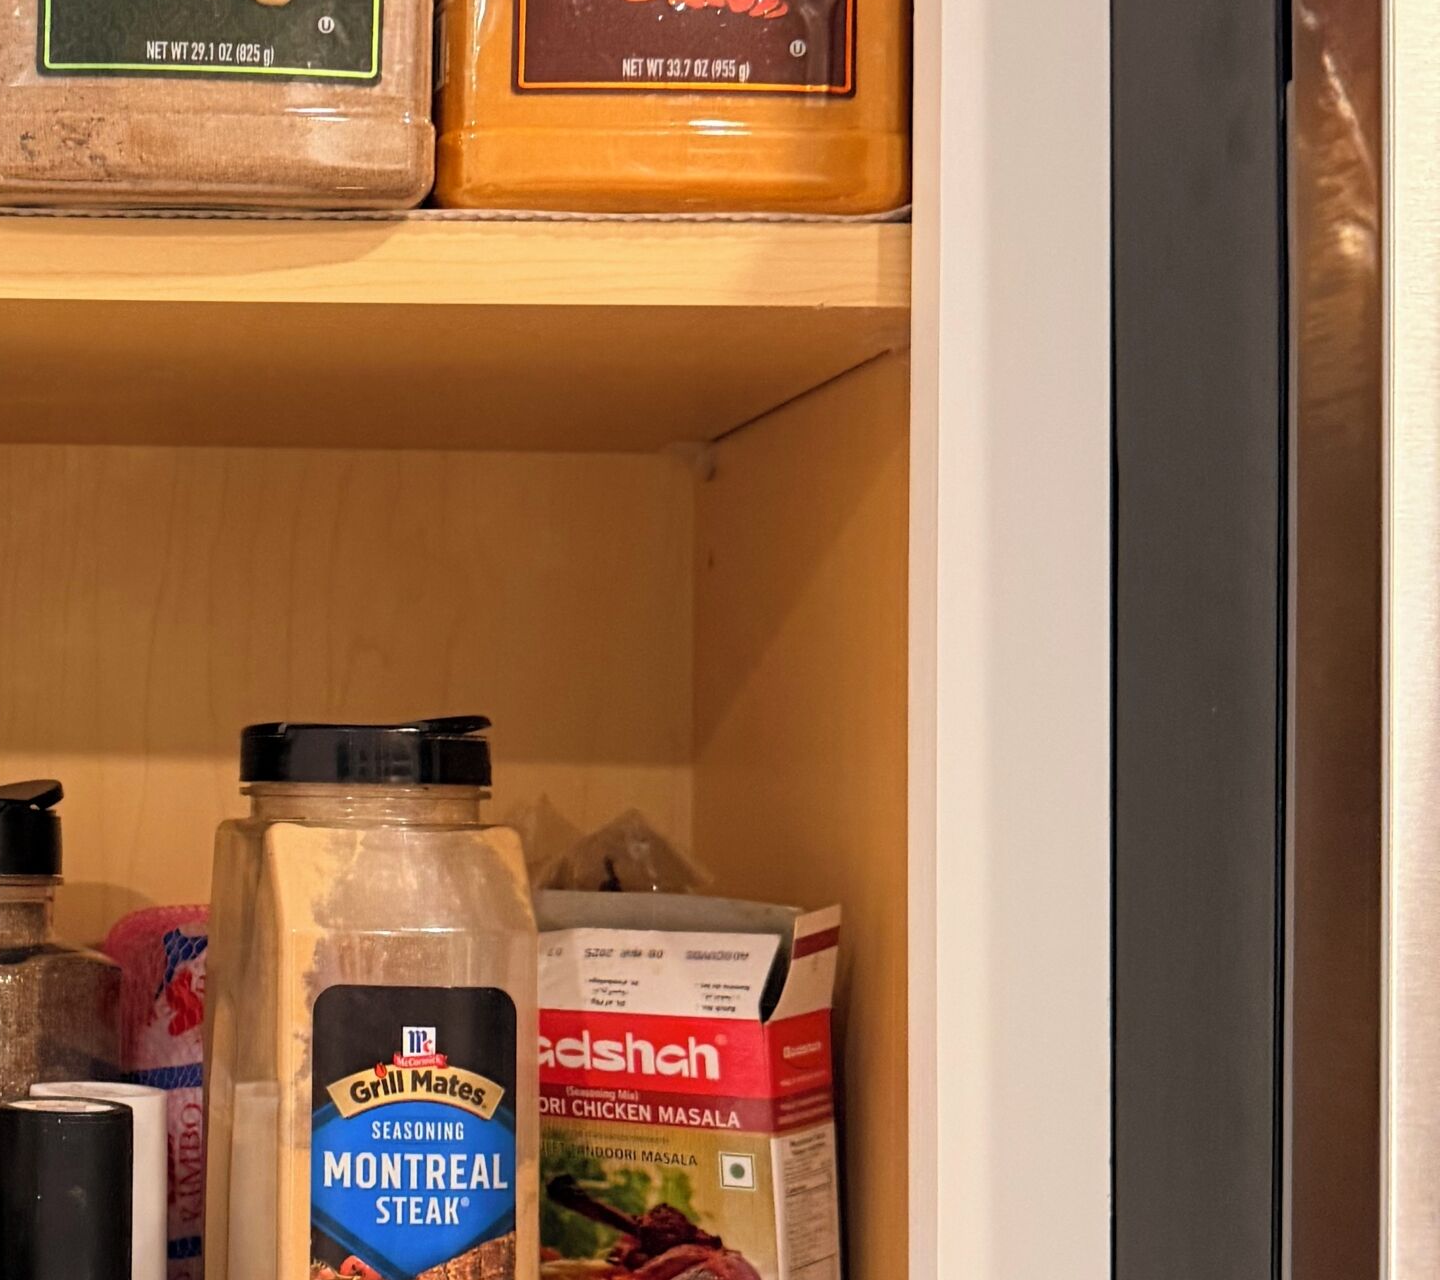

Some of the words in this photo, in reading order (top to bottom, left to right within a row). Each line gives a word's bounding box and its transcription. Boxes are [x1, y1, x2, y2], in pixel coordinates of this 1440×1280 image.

[146, 41, 167, 59] NET
[171, 42, 187, 60] WT
[191, 43, 214, 61] 29.1
[218, 44, 232, 62] OZ
[236, 44, 260, 64] (825
[264, 47, 274, 66] g)
[622, 58, 644, 77] NET
[647, 59, 663, 77] WT
[667, 60, 691, 77] 33.7
[694, 61, 708, 78] OZ
[712, 60, 735, 80] (955
[738, 62, 749, 81] g)
[540, 1030, 719, 1080] adshah
[350, 1070, 403, 1103] Grill
[572, 1099, 651, 1121] CHICKEN
[659, 1107, 740, 1128] MASALA
[372, 1121, 464, 1140] SEASONING
[324, 1151, 508, 1190] MONTREAL
[642, 1150, 697, 1166] MASALA
